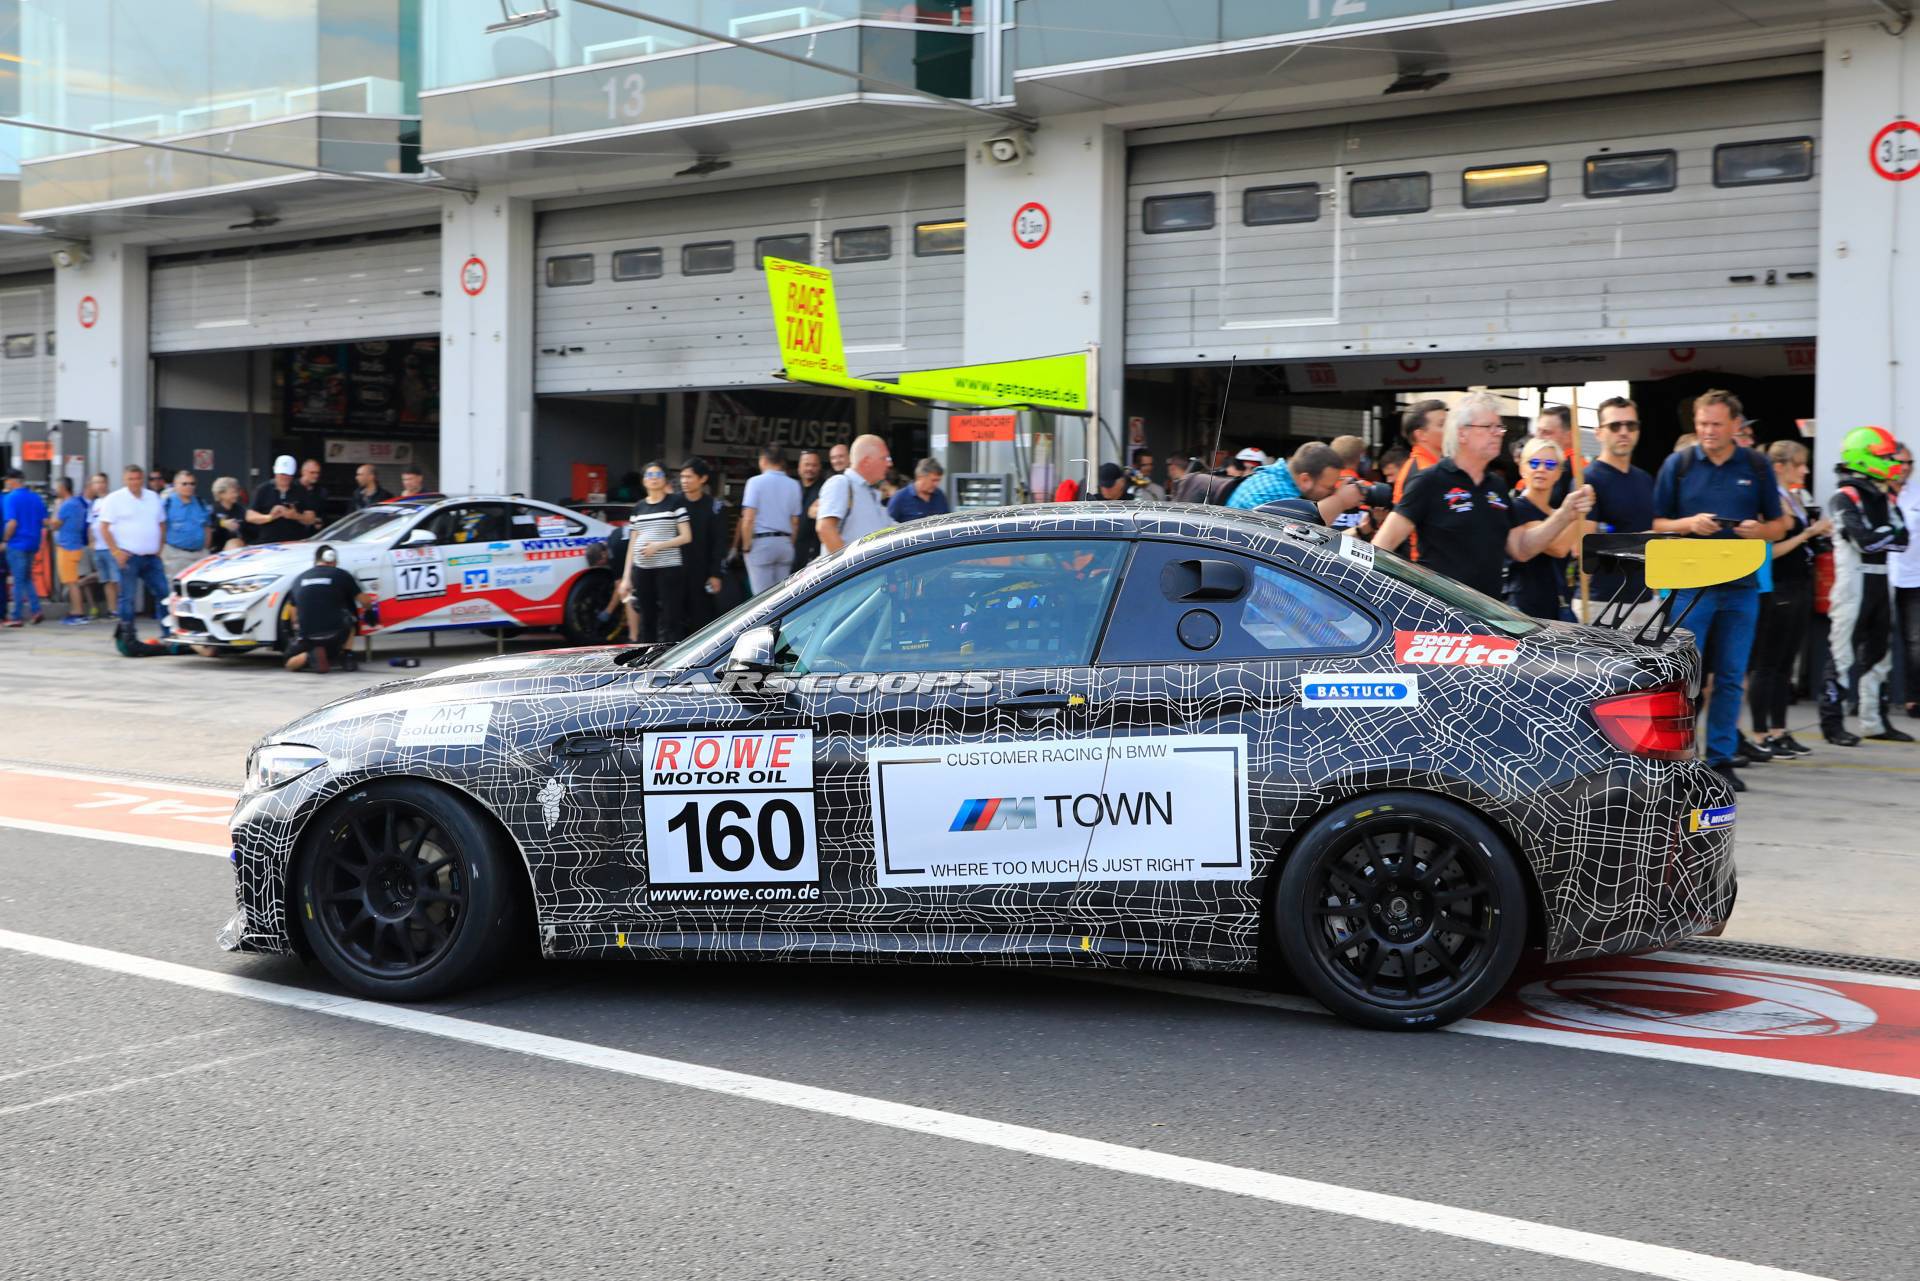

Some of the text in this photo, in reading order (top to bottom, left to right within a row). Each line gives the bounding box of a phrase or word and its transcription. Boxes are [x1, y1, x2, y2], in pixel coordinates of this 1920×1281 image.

[602, 73, 645, 120] 13
[787, 282, 825, 315] RACE
[786, 316, 823, 354] TAXI
[953, 377, 1079, 403] www.getspeed.de
[400, 565, 440, 590] 175
[1410, 634, 1473, 647] sport
[1403, 644, 1520, 665] auto
[1317, 685, 1396, 698] BASTUCK
[401, 722, 485, 736] solutions
[653, 736, 797, 770] ROWE
[946, 744, 1168, 767] CUSTOMER RACING IN BMW
[653, 770, 787, 785] MOTOR OIL
[1044, 791, 1174, 828] TOWN
[668, 799, 805, 873] 160
[931, 858, 1196, 878] WHERE TOO MUCH IS JUST RIGHT
[650, 884, 820, 901] www.rowe.com.de
